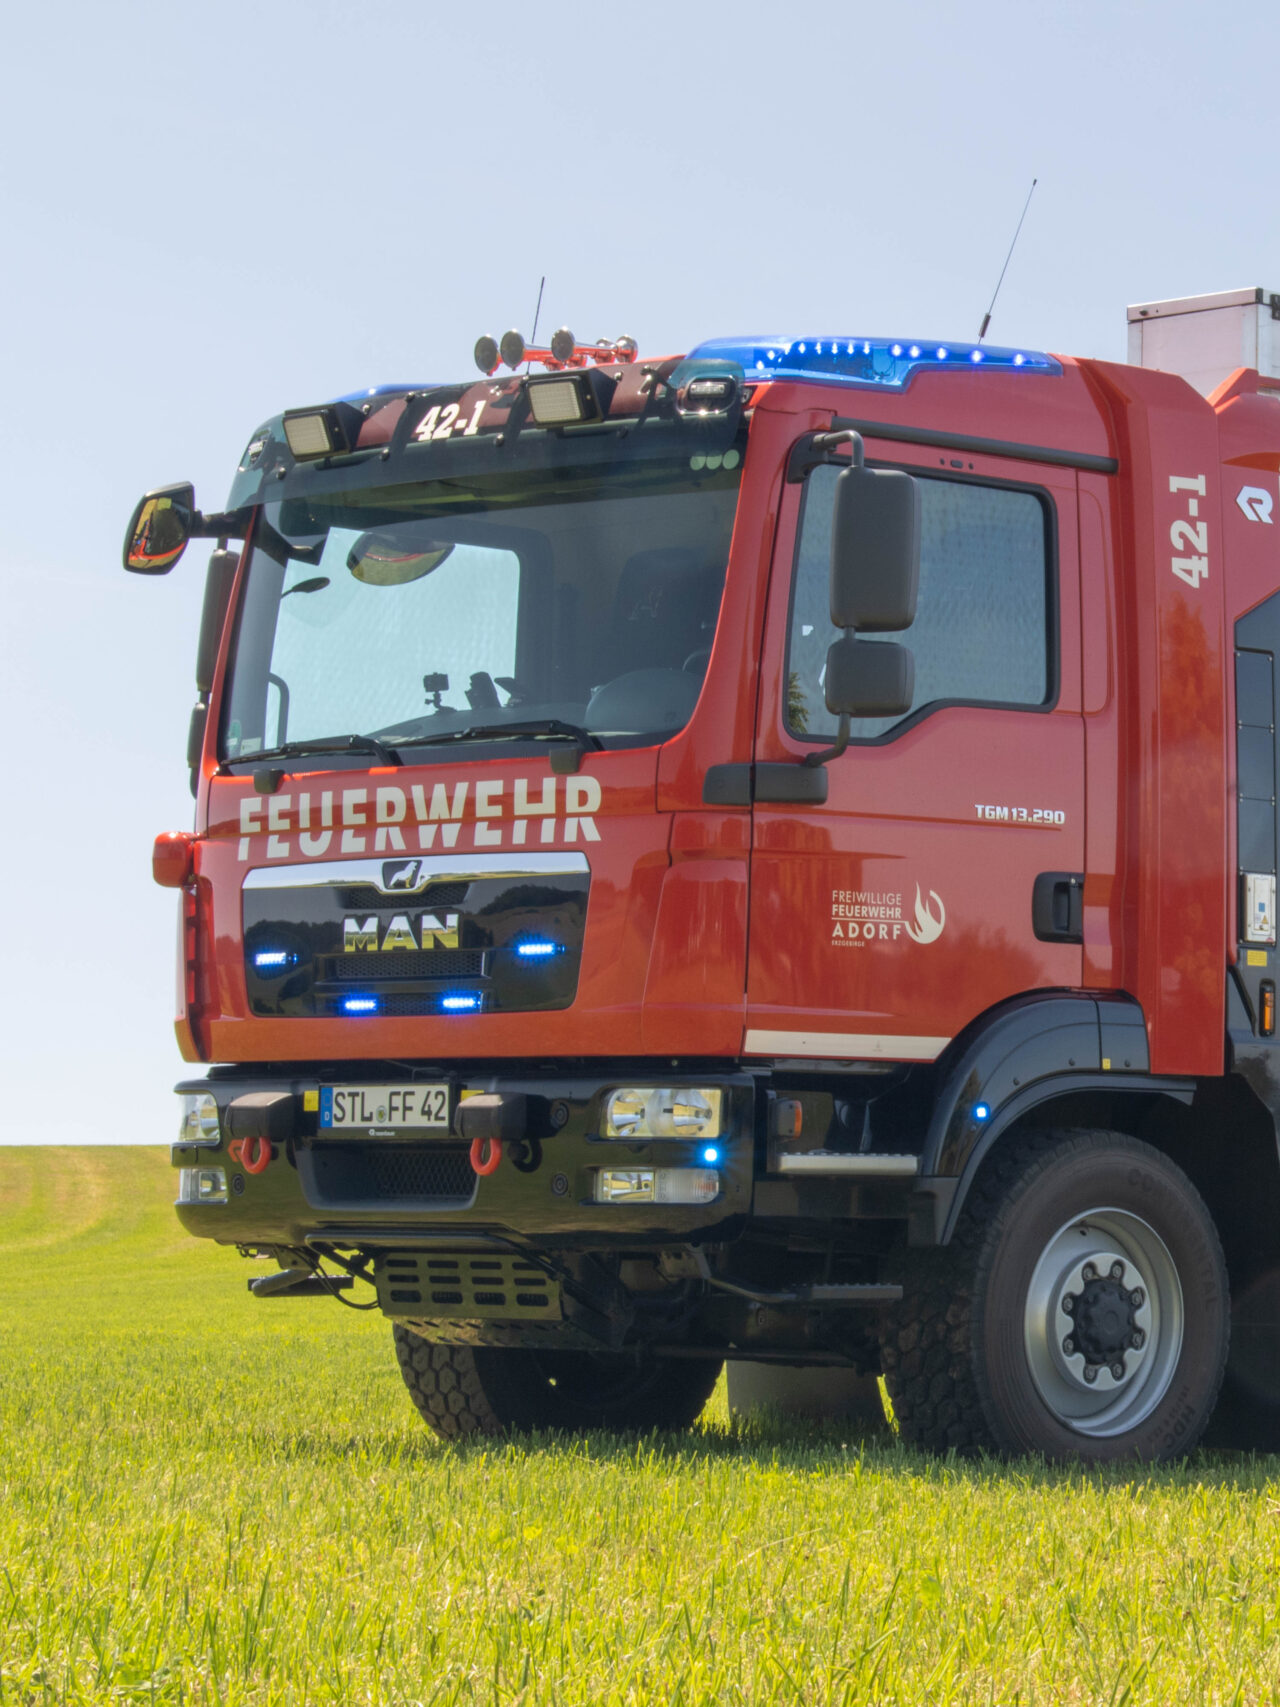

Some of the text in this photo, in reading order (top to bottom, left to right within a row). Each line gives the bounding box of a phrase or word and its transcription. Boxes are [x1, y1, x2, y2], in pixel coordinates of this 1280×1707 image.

[415, 400, 487, 442] 42-1
[1169, 474, 1208, 589] 42-1
[238, 776, 601, 860] FEUERWEHR
[974, 804, 1066, 825] TGM 13.290
[832, 890, 902, 906] FREIWILLIGE
[832, 904, 902, 919] FEUERWEHR
[344, 913, 459, 951] MAN
[832, 921, 902, 940] ADORF
[333, 1090, 446, 1123] STL FF 42
